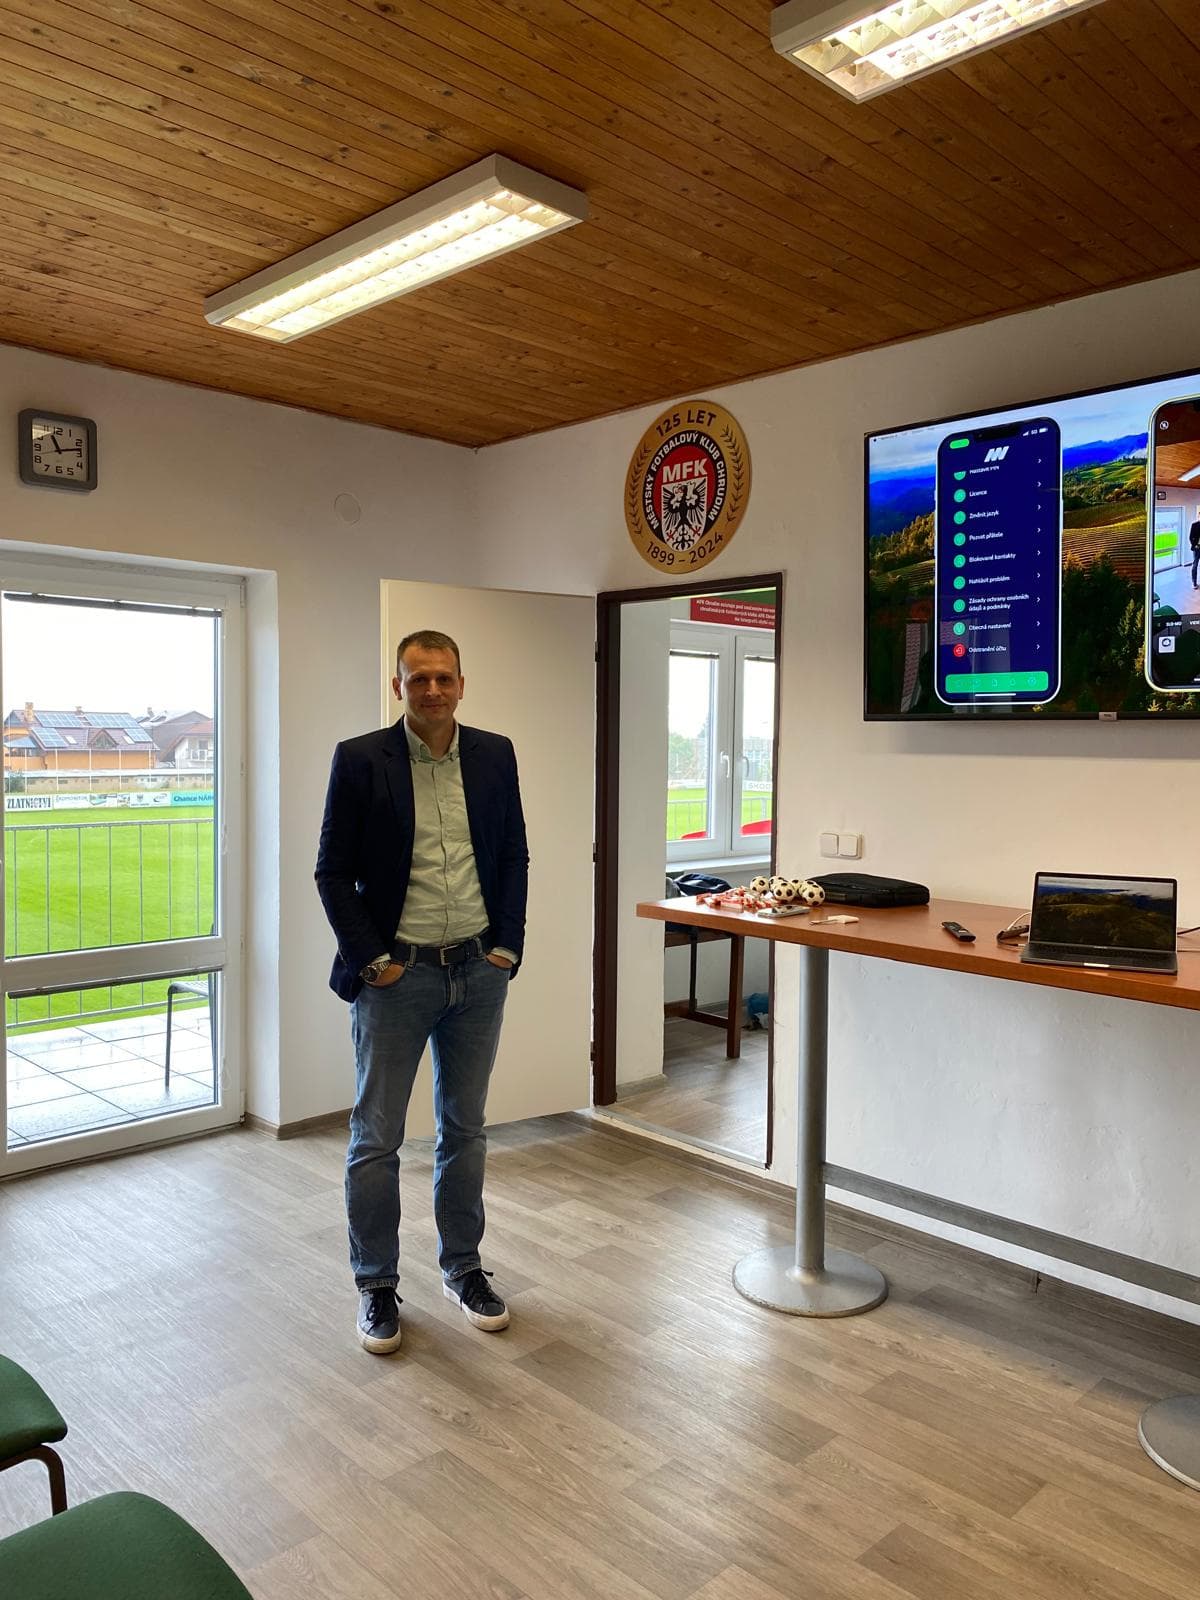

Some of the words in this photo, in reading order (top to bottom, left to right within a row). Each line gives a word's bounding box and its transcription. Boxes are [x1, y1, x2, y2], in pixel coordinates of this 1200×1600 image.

[54, 426, 63, 436] 12
[656, 413, 681, 437] 125
[687, 410, 717, 427] LET
[34, 444, 42, 452] 9
[76, 438, 82, 447] 2
[651, 430, 699, 473] FOTBALOVÝ
[699, 435, 720, 461] KLUB
[34, 455, 42, 464] 8
[66, 468, 74, 476] 5
[662, 458, 708, 483] MFK
[645, 474, 659, 530] MĚSTSKÝ
[708, 461, 727, 522] CHRUDIM
[646, 541, 675, 566] 1899
[689, 531, 724, 564] 2024
